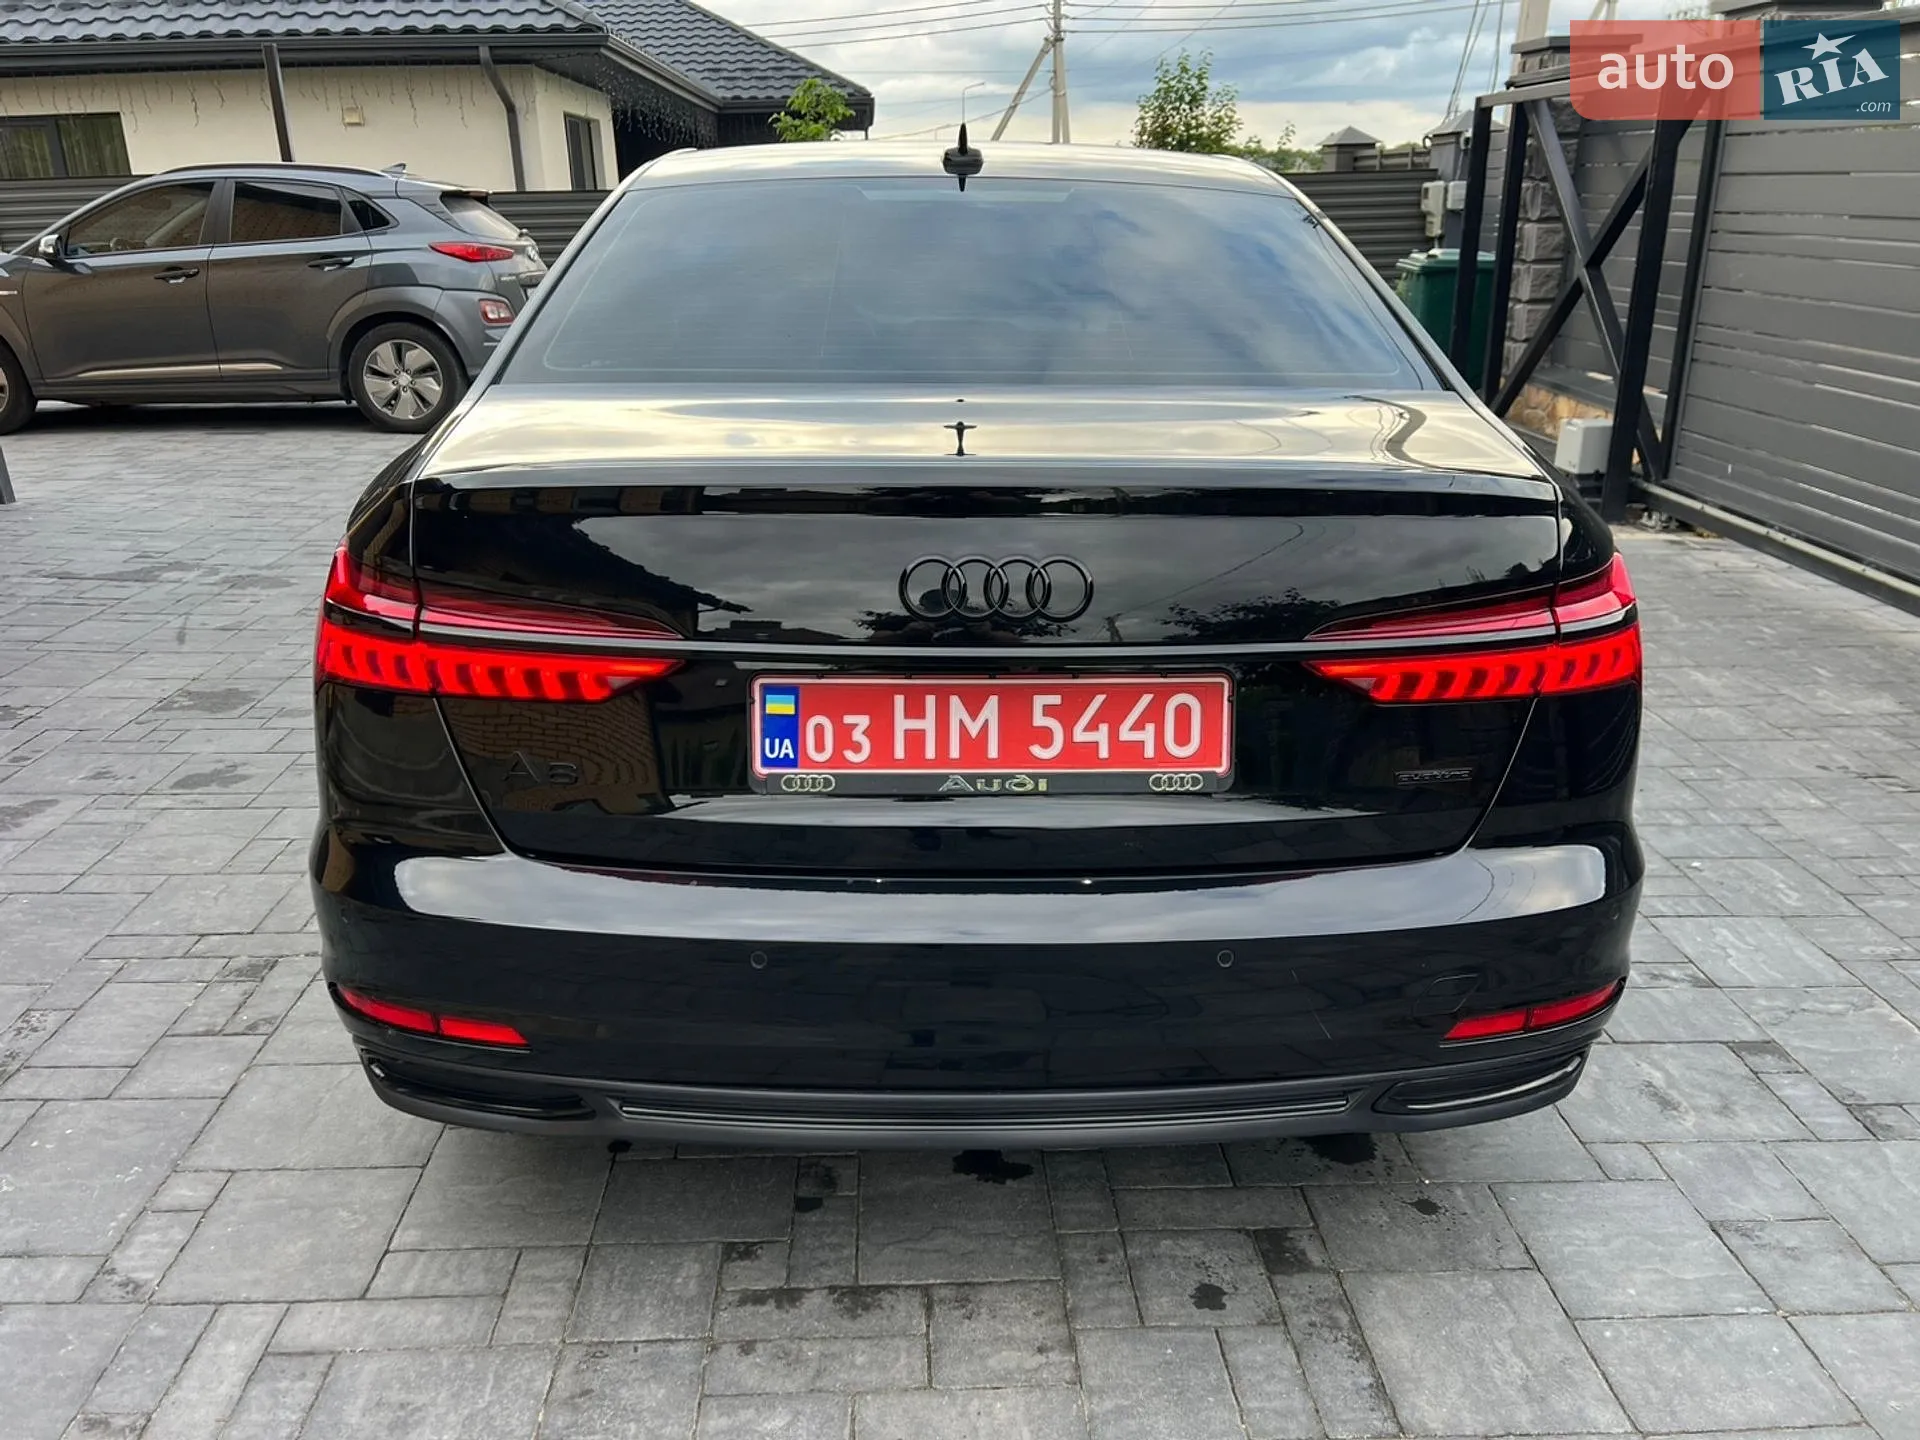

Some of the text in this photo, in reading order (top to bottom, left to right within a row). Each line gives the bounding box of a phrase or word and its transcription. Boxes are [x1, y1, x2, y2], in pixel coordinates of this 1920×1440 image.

[805, 693, 1202, 763] 03 HM 5440
[765, 738, 795, 760] UA
[938, 775, 1048, 793] Audi
